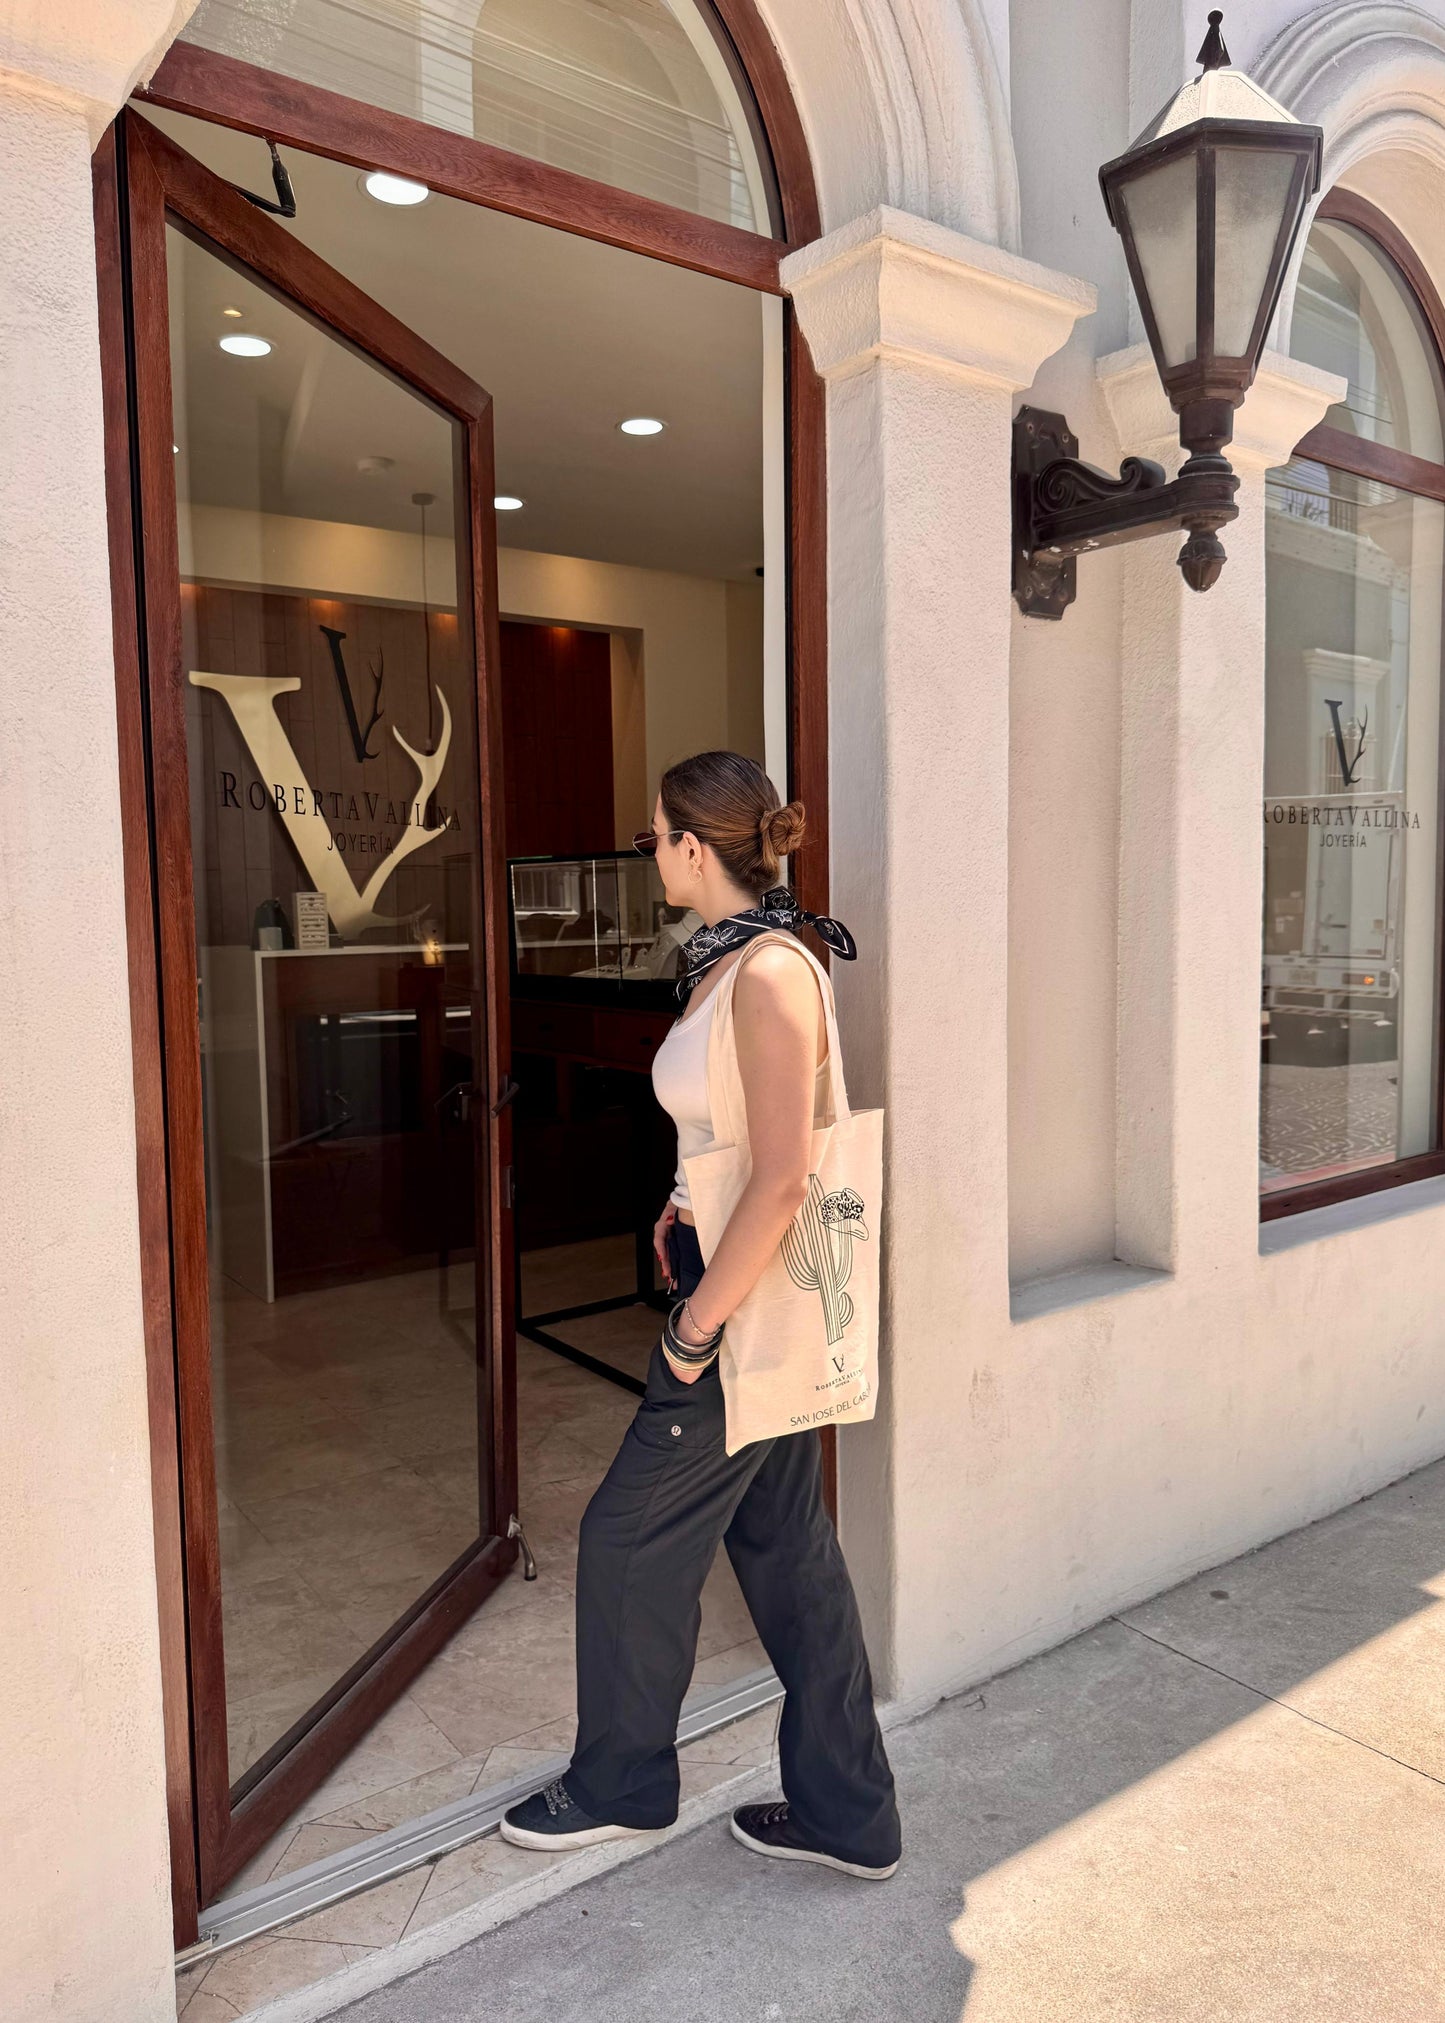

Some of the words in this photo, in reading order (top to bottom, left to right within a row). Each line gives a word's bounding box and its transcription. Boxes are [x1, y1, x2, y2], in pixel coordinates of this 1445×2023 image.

[327, 831, 394, 854] JOYERÍA
[1320, 832, 1367, 848] JOYERÍA
[790, 1413, 810, 1427] SAN
[812, 1406, 835, 1423] JOSE
[836, 1400, 852, 1414] DEL
